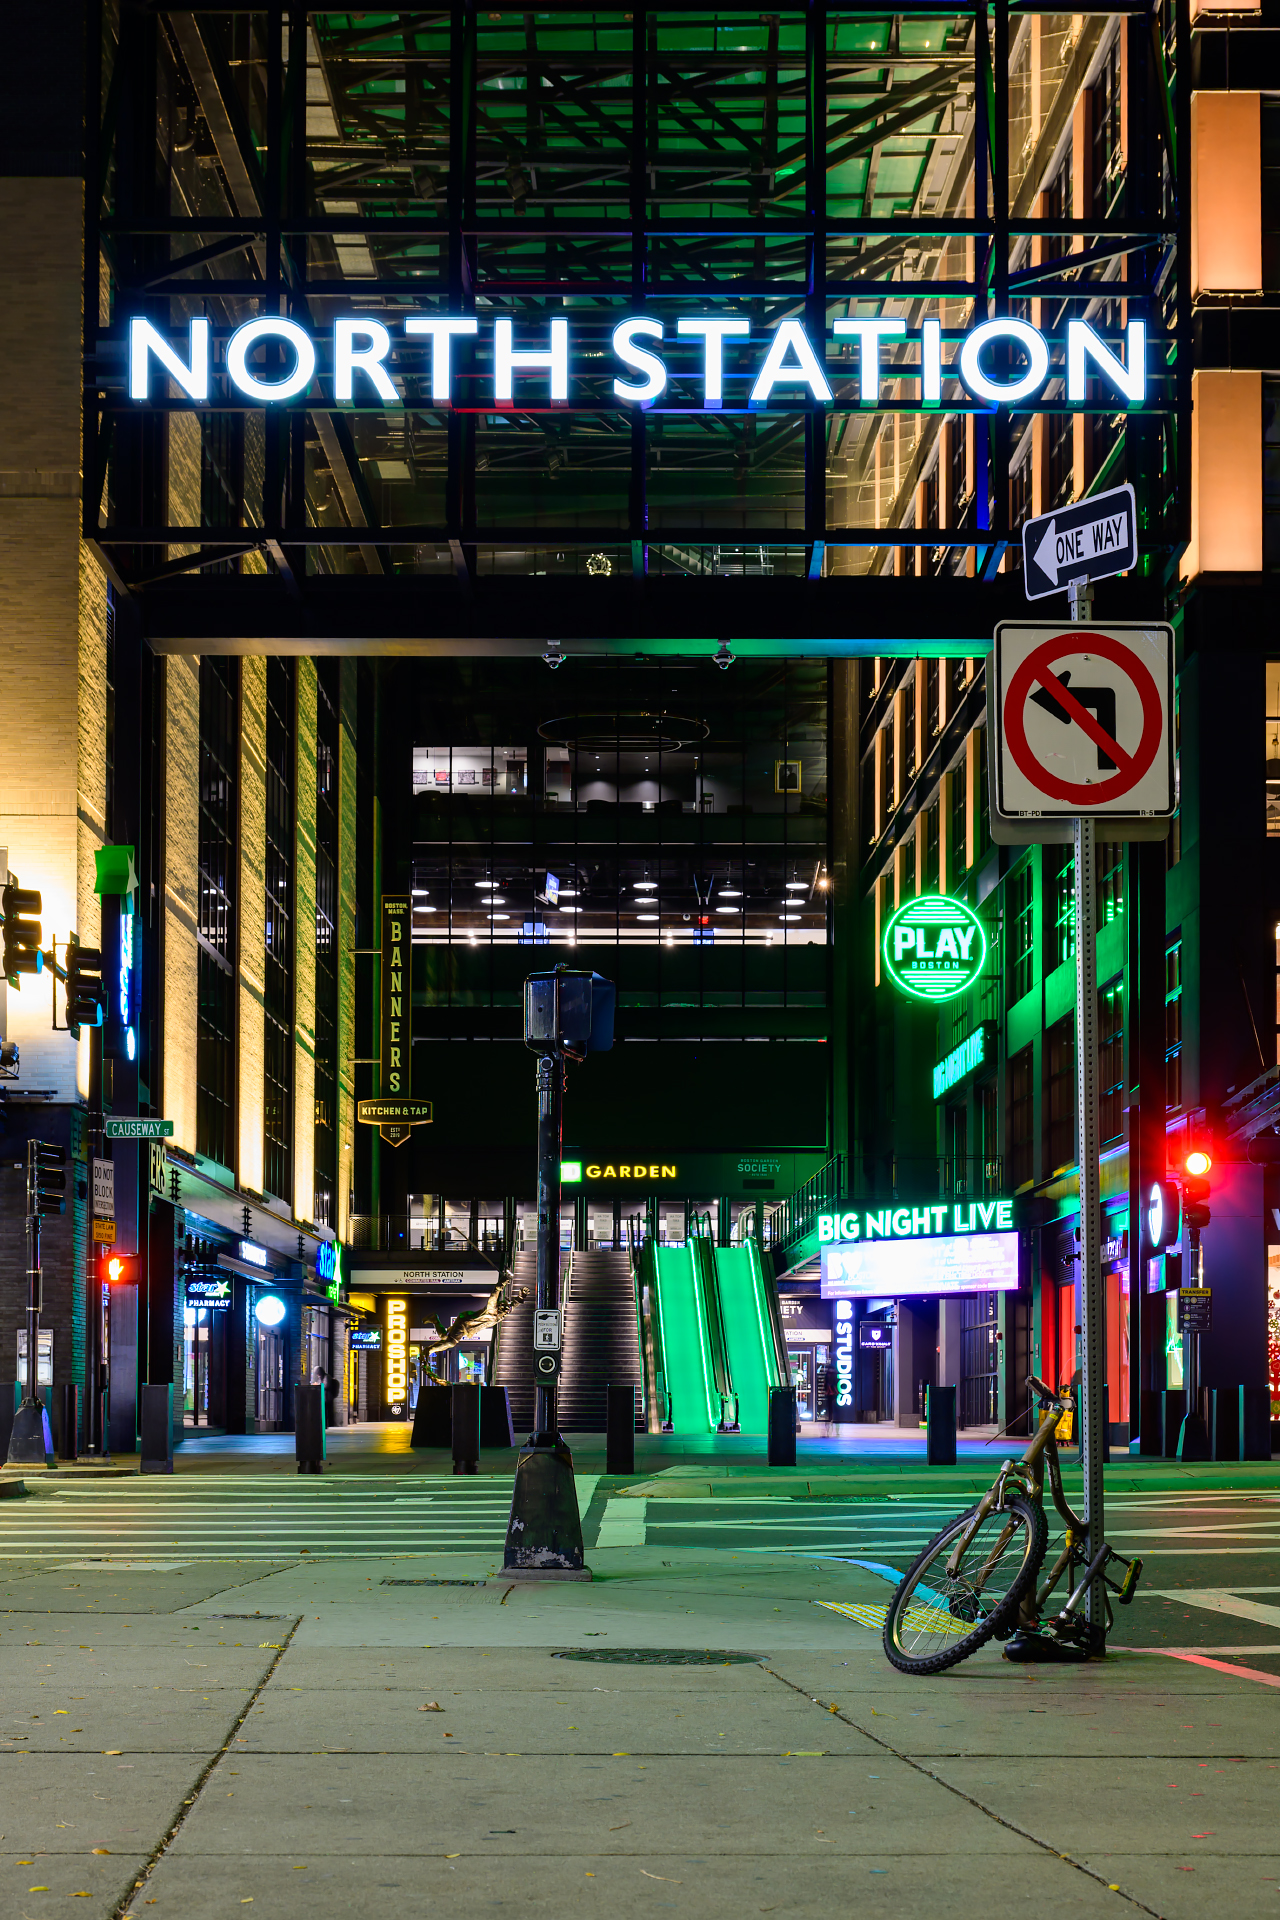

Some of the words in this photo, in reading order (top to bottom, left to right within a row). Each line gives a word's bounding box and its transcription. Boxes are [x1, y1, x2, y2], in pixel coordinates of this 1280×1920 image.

[129, 315, 569, 401] NORTH
[611, 315, 1147, 401] STATION
[1055, 529, 1085, 564] ONE
[1092, 516, 1123, 553] WAY
[911, 961, 960, 970] BOSTON
[389, 921, 403, 1093] BANNERS
[361, 1107, 401, 1116] KITCHEN
[402, 1107, 409, 1116] &
[410, 1107, 428, 1116] TAP
[111, 1123, 162, 1136] CAUSEWAY
[163, 1128, 170, 1136] ST
[94, 1166, 102, 1180] DO
[102, 1167, 114, 1182] NOT
[585, 1165, 677, 1179] GARDEN
[737, 1163, 782, 1173] SOCIETY
[94, 1183, 114, 1199] BLOCK
[95, 1222, 106, 1230] STATE
[818, 1213, 860, 1242] BIG
[865, 1205, 948, 1239] NIGHT
[953, 1200, 1014, 1232] LIVE
[320, 1239, 336, 1280] star
[187, 1281, 218, 1293] star
[188, 1299, 231, 1307] PHARMACY
[352, 1331, 371, 1339] star
[387, 1299, 407, 1403] PROSHOP
[836, 1321, 853, 1407] STUDIOS
